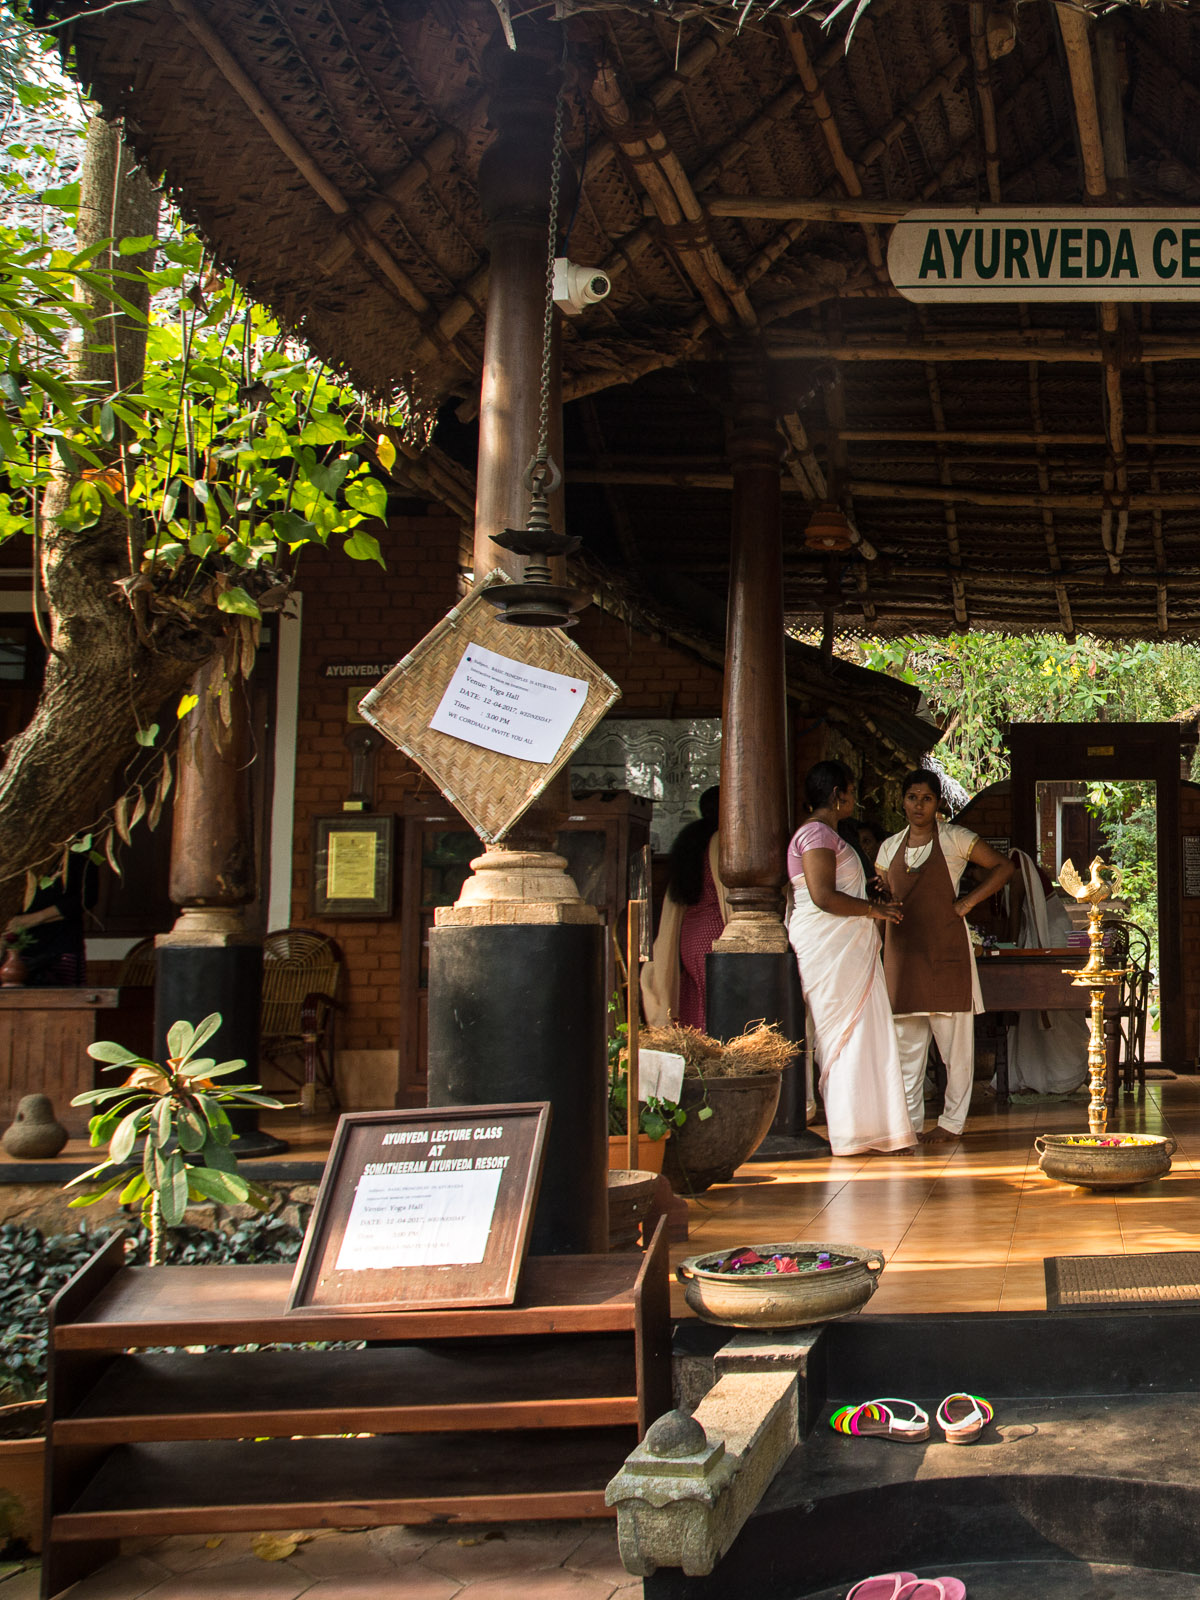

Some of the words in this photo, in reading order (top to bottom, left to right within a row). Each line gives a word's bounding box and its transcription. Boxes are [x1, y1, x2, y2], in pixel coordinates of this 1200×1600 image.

[918, 228, 1139, 279] AYURVEDA
[326, 665, 380, 676] AYURVEDA
[466, 675, 487, 689] Venue:
[489, 685, 504, 696] Yoga
[505, 690, 519, 700] Hall
[454, 700, 470, 711] Time
[499, 717, 511, 725] PM
[460, 687, 481, 700] DATE:
[519, 710, 552, 723] WEDNESDAY
[458, 716, 490, 731] CORDIALLY
[491, 727, 510, 737] INVITE
[511, 734, 523, 742] YOU
[382, 1131, 428, 1145] AYURVEDA
[430, 1129, 472, 1142] LECTURE
[473, 1126, 503, 1140] CLASS
[428, 1145, 446, 1157] AT
[363, 1161, 427, 1175] SOMATHEERAM
[428, 1159, 472, 1172] AYURVEDA
[474, 1156, 510, 1169] RESORT
